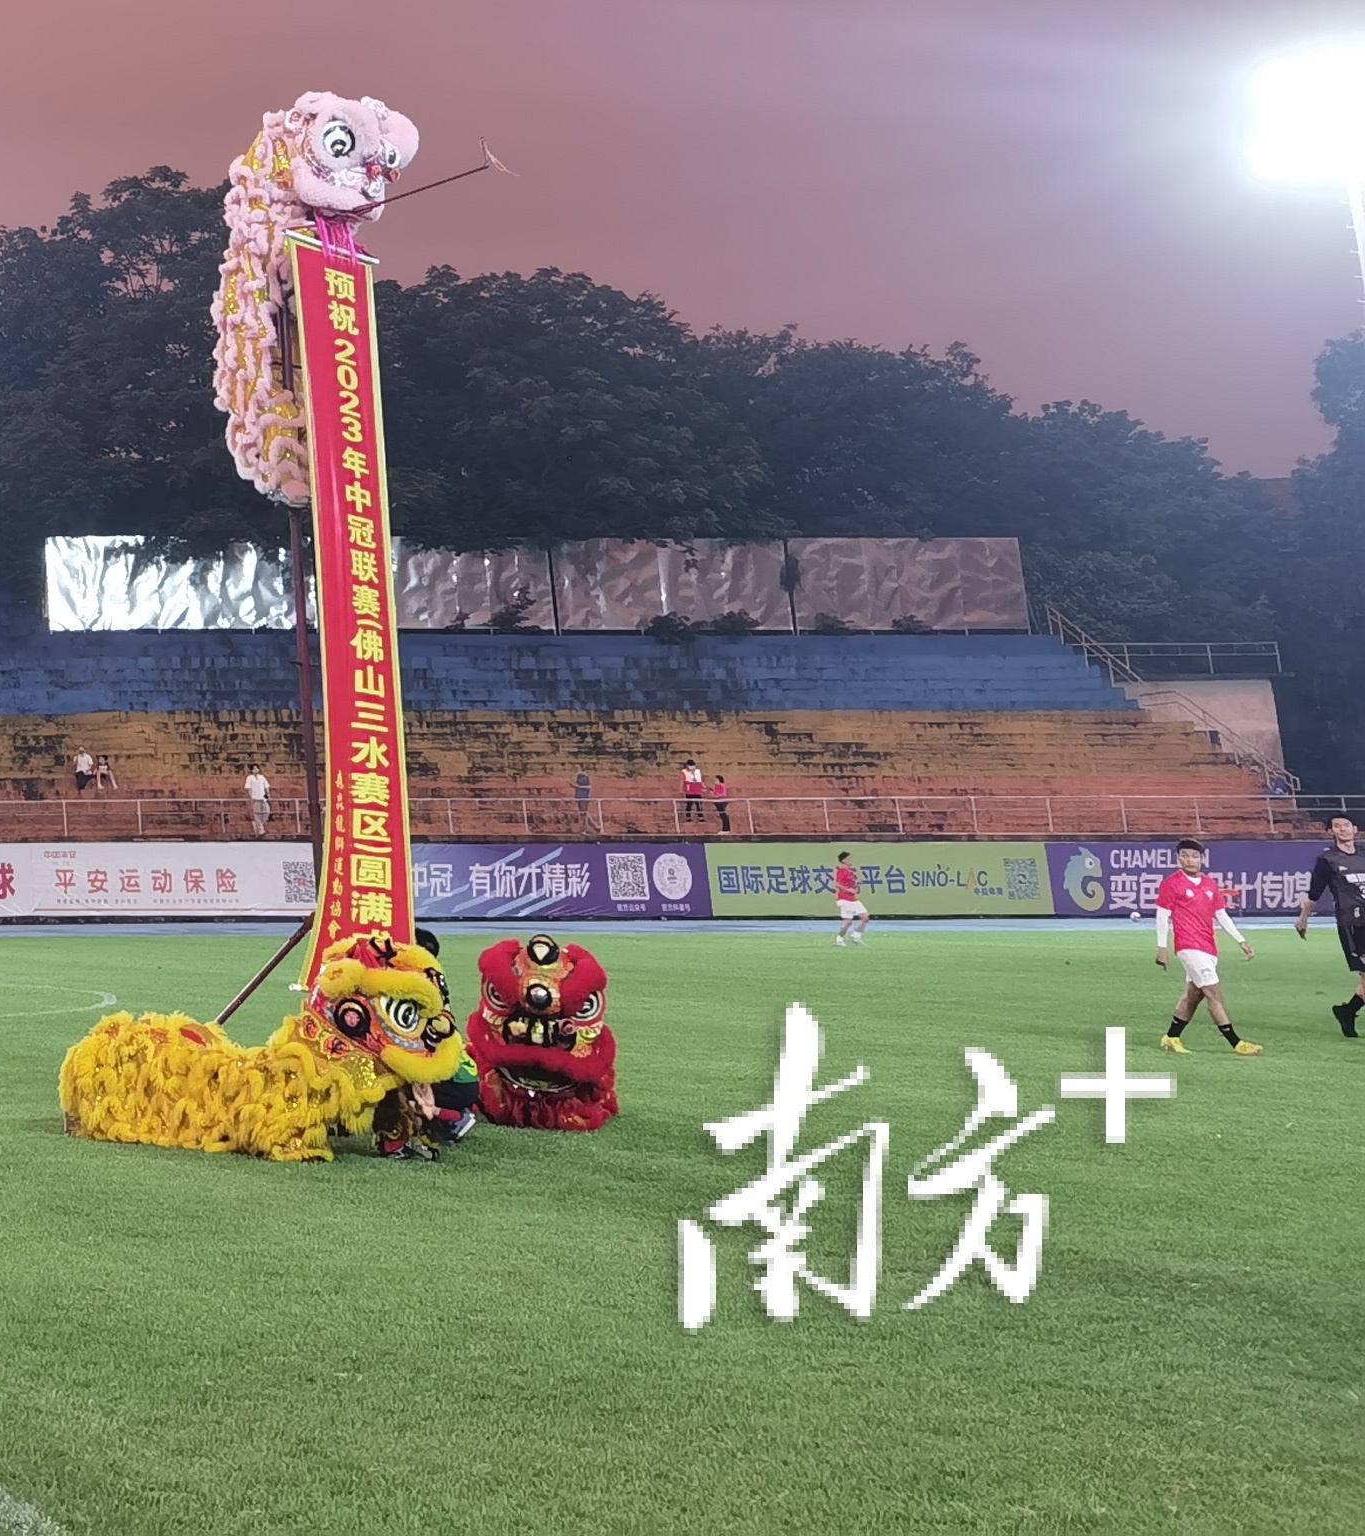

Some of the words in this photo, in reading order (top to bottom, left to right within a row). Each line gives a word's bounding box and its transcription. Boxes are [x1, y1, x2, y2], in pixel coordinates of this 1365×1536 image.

[1110, 849, 1209, 869] CHAMELN
[54, 868, 238, 894] 平安运动保险
[469, 863, 589, 898] 有你才精彩
[911, 868, 988, 889] SINO-LAC
